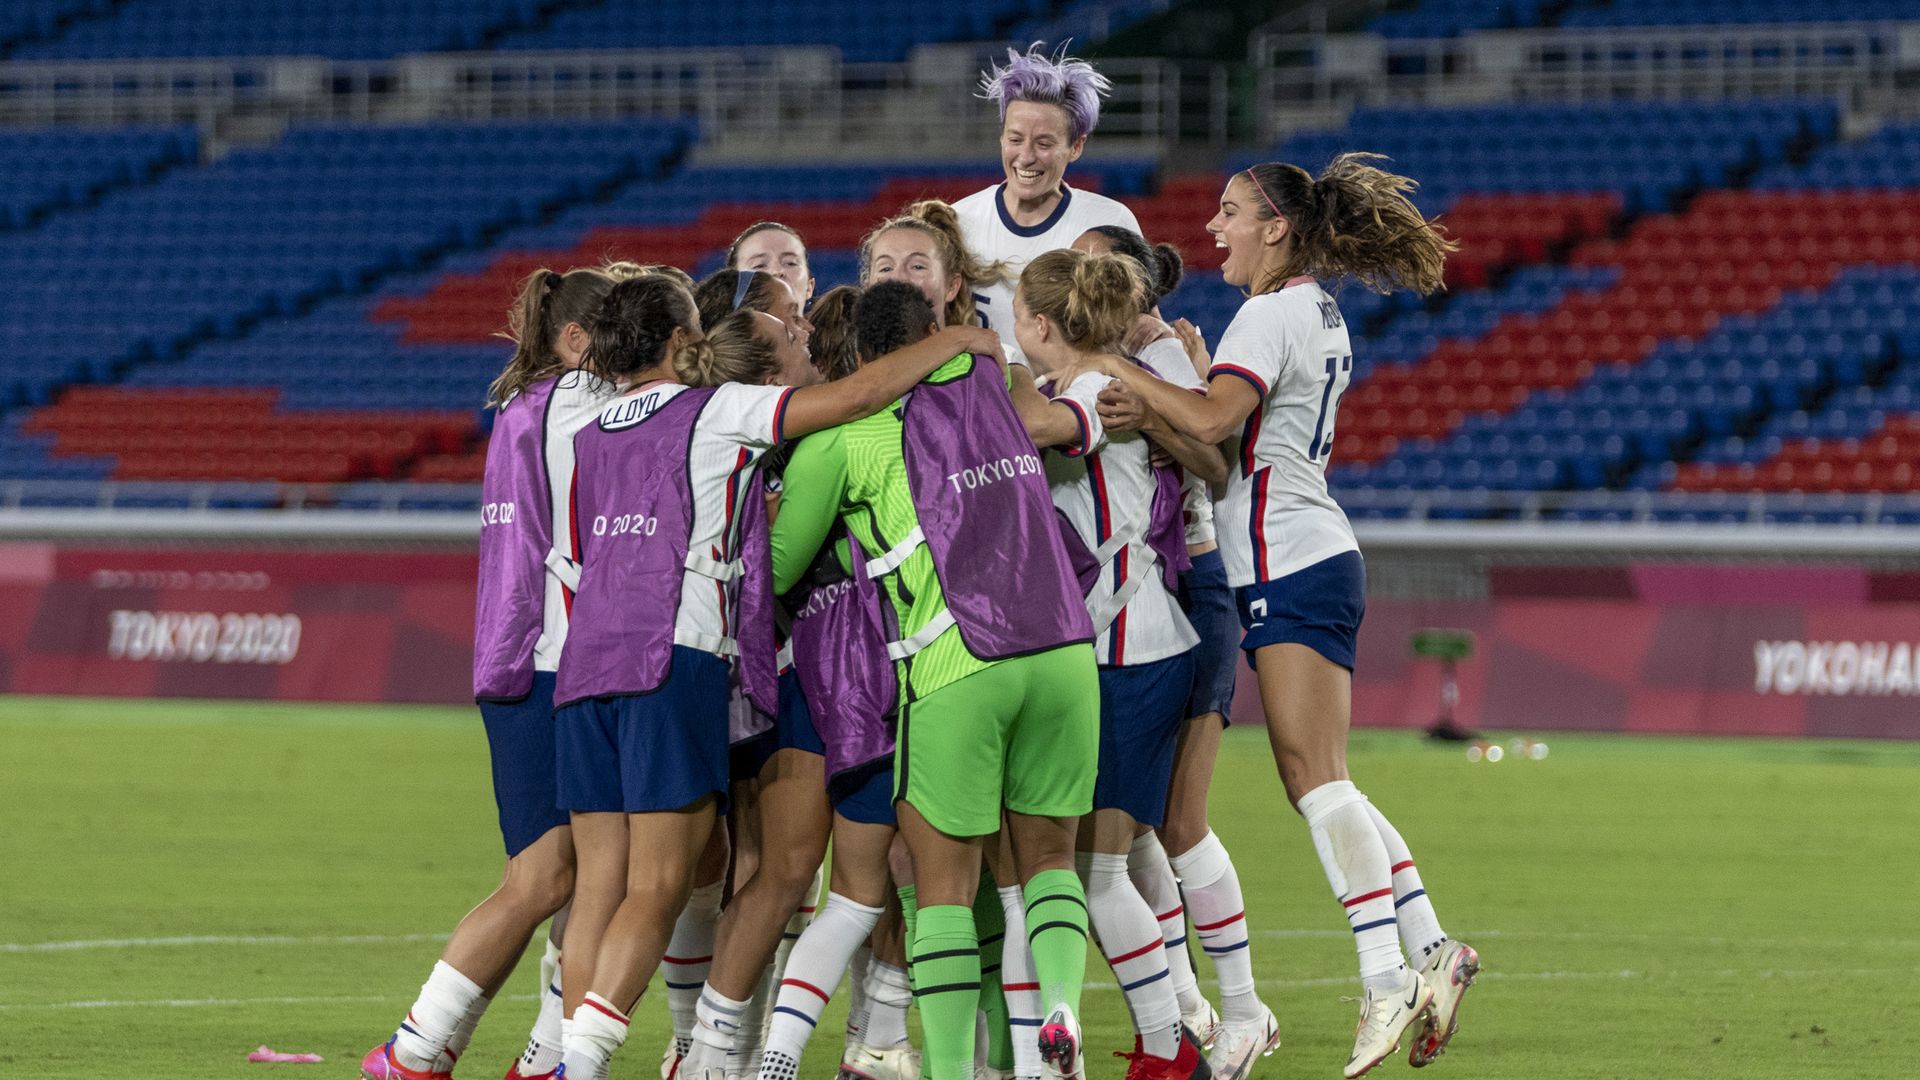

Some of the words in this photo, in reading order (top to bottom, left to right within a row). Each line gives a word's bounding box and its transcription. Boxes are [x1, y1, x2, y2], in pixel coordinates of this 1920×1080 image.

[603, 392, 660, 425] LLOYD
[947, 458, 1015, 494] TOKYO
[610, 513, 658, 537] 2020
[108, 610, 220, 664] TOKYO
[214, 611, 302, 665] 2020
[1754, 639, 1920, 697] YOKOHA
